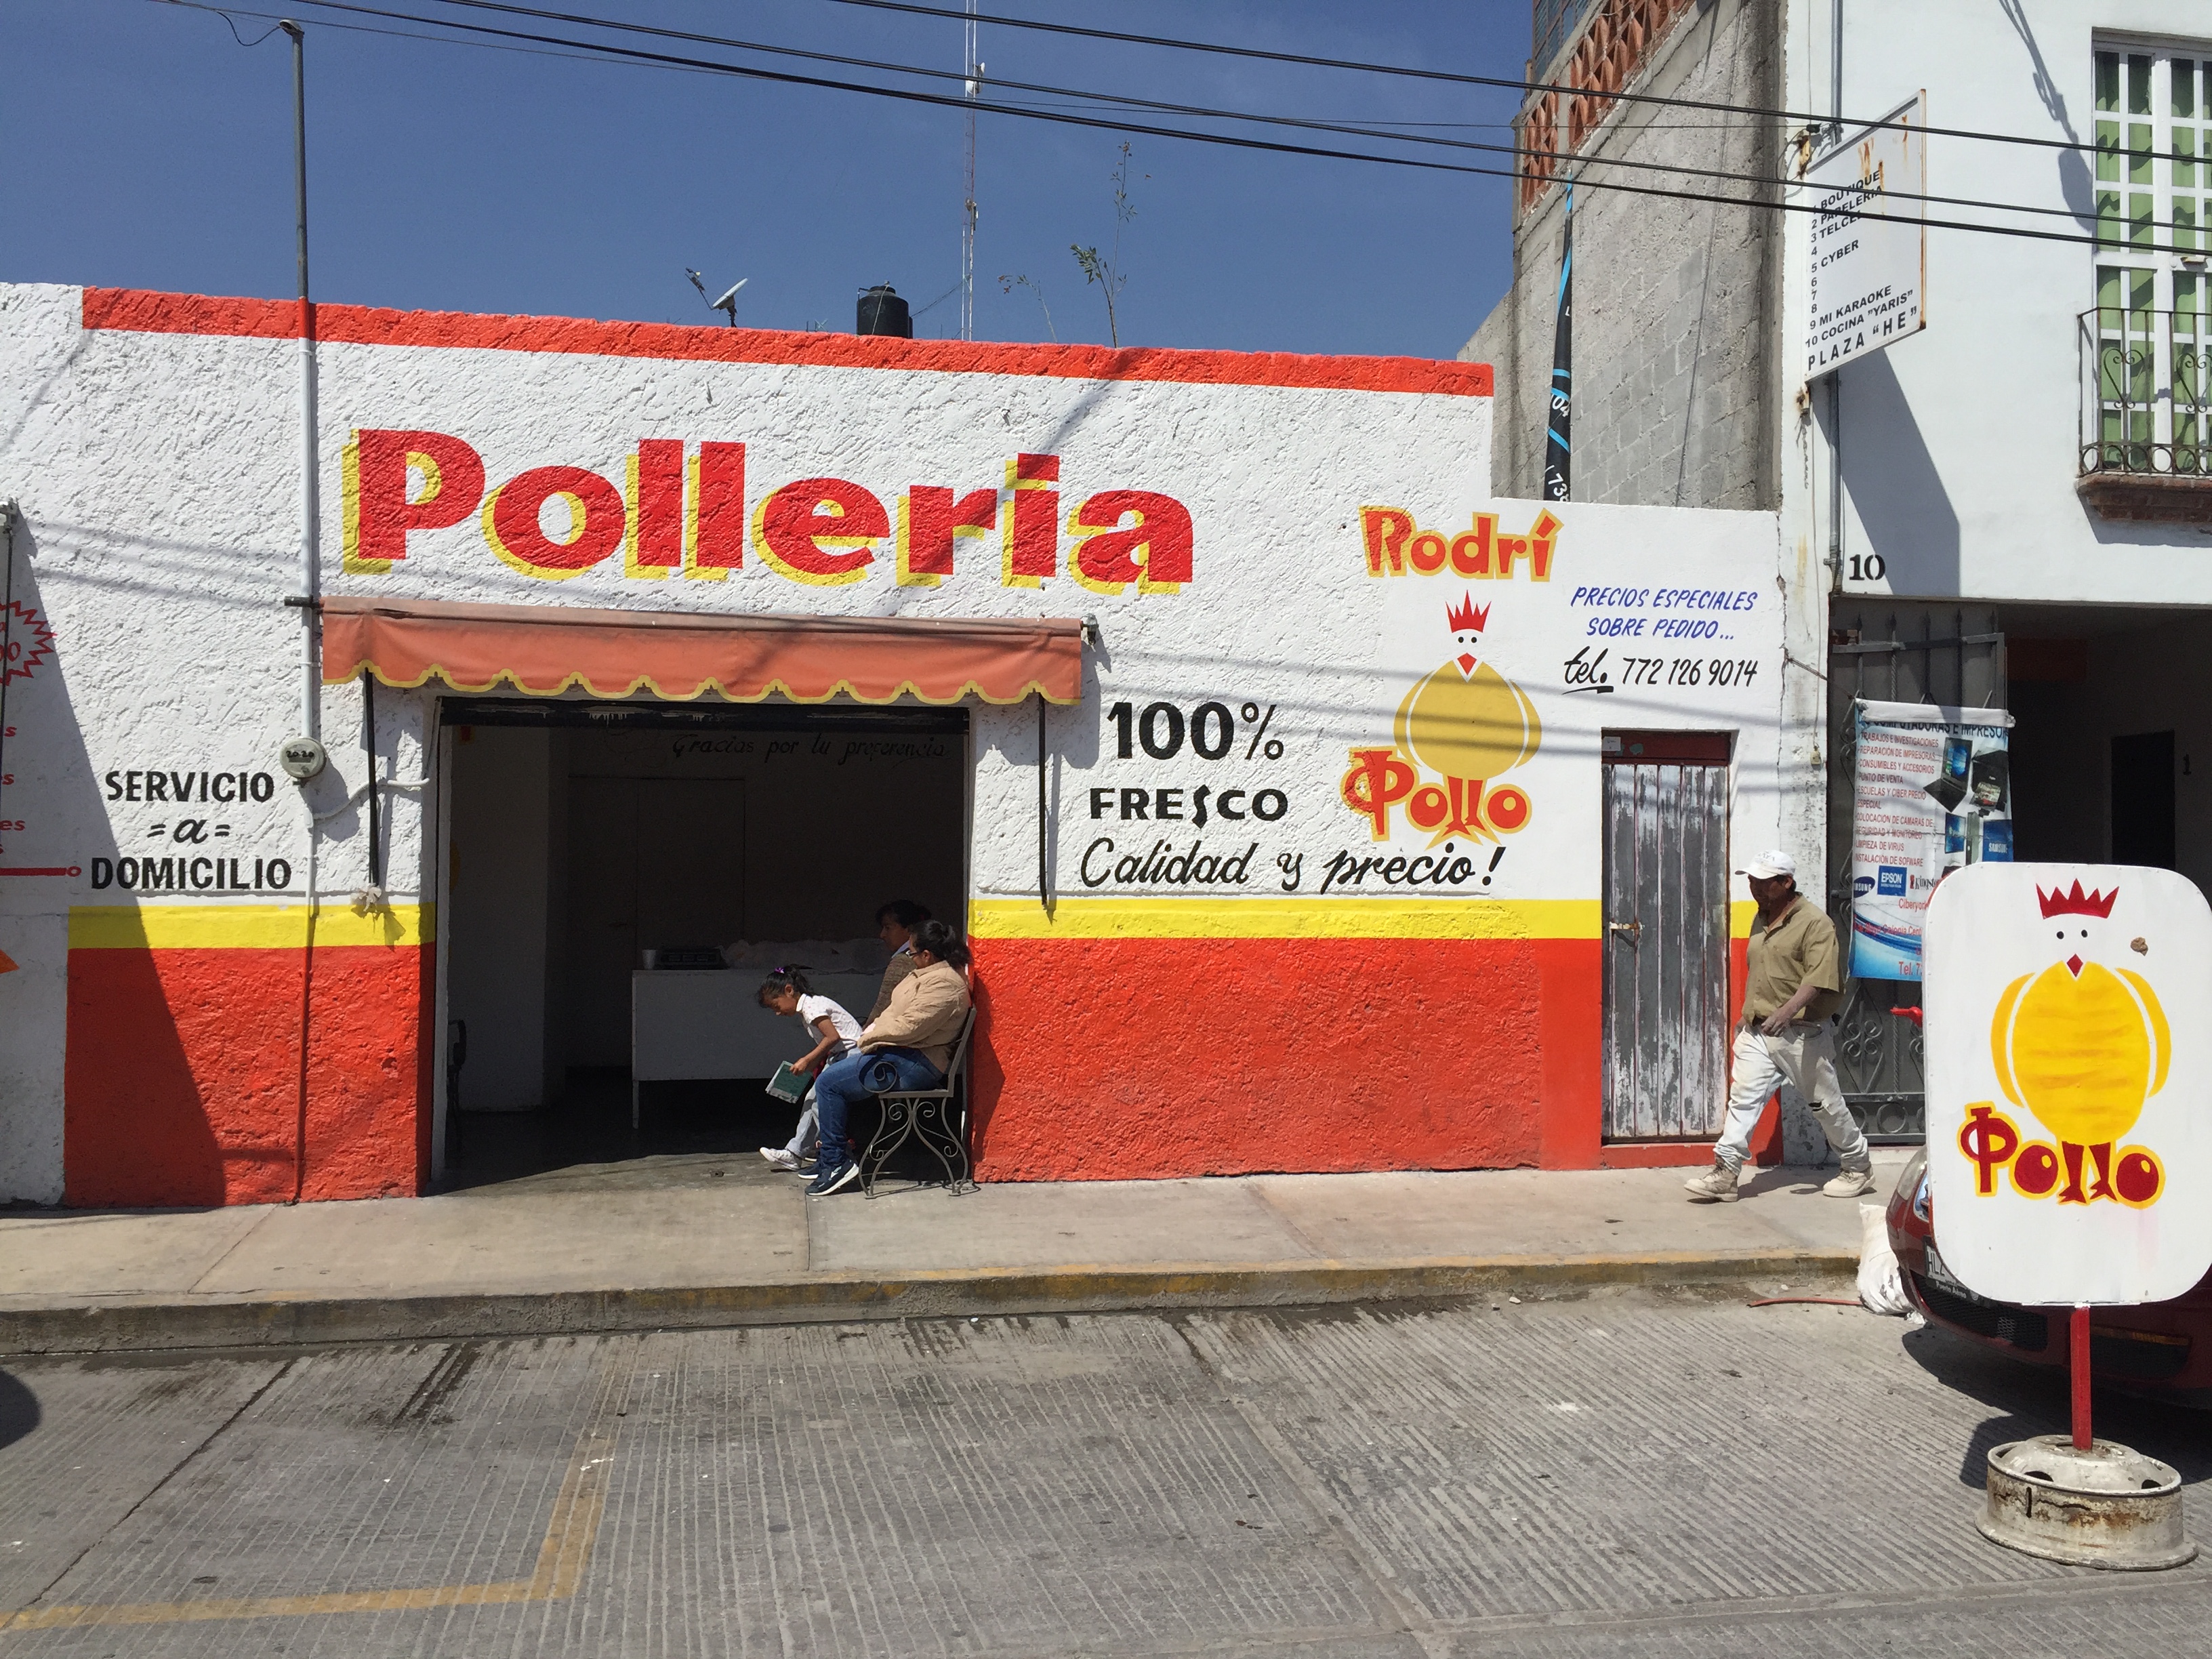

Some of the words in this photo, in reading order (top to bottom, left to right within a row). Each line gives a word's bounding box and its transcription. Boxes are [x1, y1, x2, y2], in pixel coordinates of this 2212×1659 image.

[1811, 219, 1817, 230] 2
[1810, 232, 1817, 243] 3
[1811, 246, 1818, 255] 4
[1811, 262, 1818, 272] 5
[1820, 239, 1859, 268] CYBER
[1811, 276, 1818, 287] 6
[1811, 290, 1818, 300] 7
[1809, 320, 1816, 330] 9
[1819, 312, 1832, 326] MI
[1836, 285, 1891, 319] KARAOKE
[1811, 303, 1818, 314] 8
[1805, 335, 1818, 348] 10
[1821, 314, 1864, 341] COCINA
[1808, 331, 1864, 371] PLAZA
[342, 428, 1194, 594] Polleria
[1357, 505, 1564, 582] Rodrí
[1848, 554, 1886, 581] 10
[1570, 586, 1650, 607] PRECIOS
[1652, 588, 1758, 611] ESPECIALES
[1586, 616, 1647, 637] SOBRE
[1622, 657, 1664, 685] 772
[1667, 658, 1704, 686] 126
[1708, 659, 1759, 687] 9014
[1107, 701, 1284, 760] 100%
[672, 734, 754, 759] Gracias
[764, 741, 801, 764] por
[838, 737, 949, 766] preferencia
[1858, 771, 1876, 781] PUNTO
[1877, 773, 1885, 783] DE
[1886, 774, 1904, 784] VENTA
[1859, 758, 1897, 770] CONSUMIBLES
[1902, 762, 1935, 775] ACCESORIOS
[105, 770, 274, 802] SERVICIO
[1339, 746, 1532, 847] Pollo
[1858, 785, 1885, 796] ESCUELAS
[1891, 788, 1908, 798] CIBER
[1908, 790, 1927, 800] PRECIO
[1090, 784, 1288, 829] FRESCO
[1857, 798, 1881, 810] ESPECIAL
[1892, 815, 1899, 825] DE
[1856, 840, 1878, 850] LIMPIEZA
[1879, 840, 1887, 851] DE
[1887, 842, 1905, 852] VIRUS
[1080, 837, 1259, 887] Calidad
[1276, 851, 1301, 891] y
[1889, 855, 1898, 865] DE
[91, 856, 292, 889] DOMICILIO
[1881, 872, 1902, 884] EPSON
[1915, 876, 1939, 890] Kingsto
[1898, 961, 1913, 976] Tel.
[1957, 1101, 2165, 1210] Pollo
